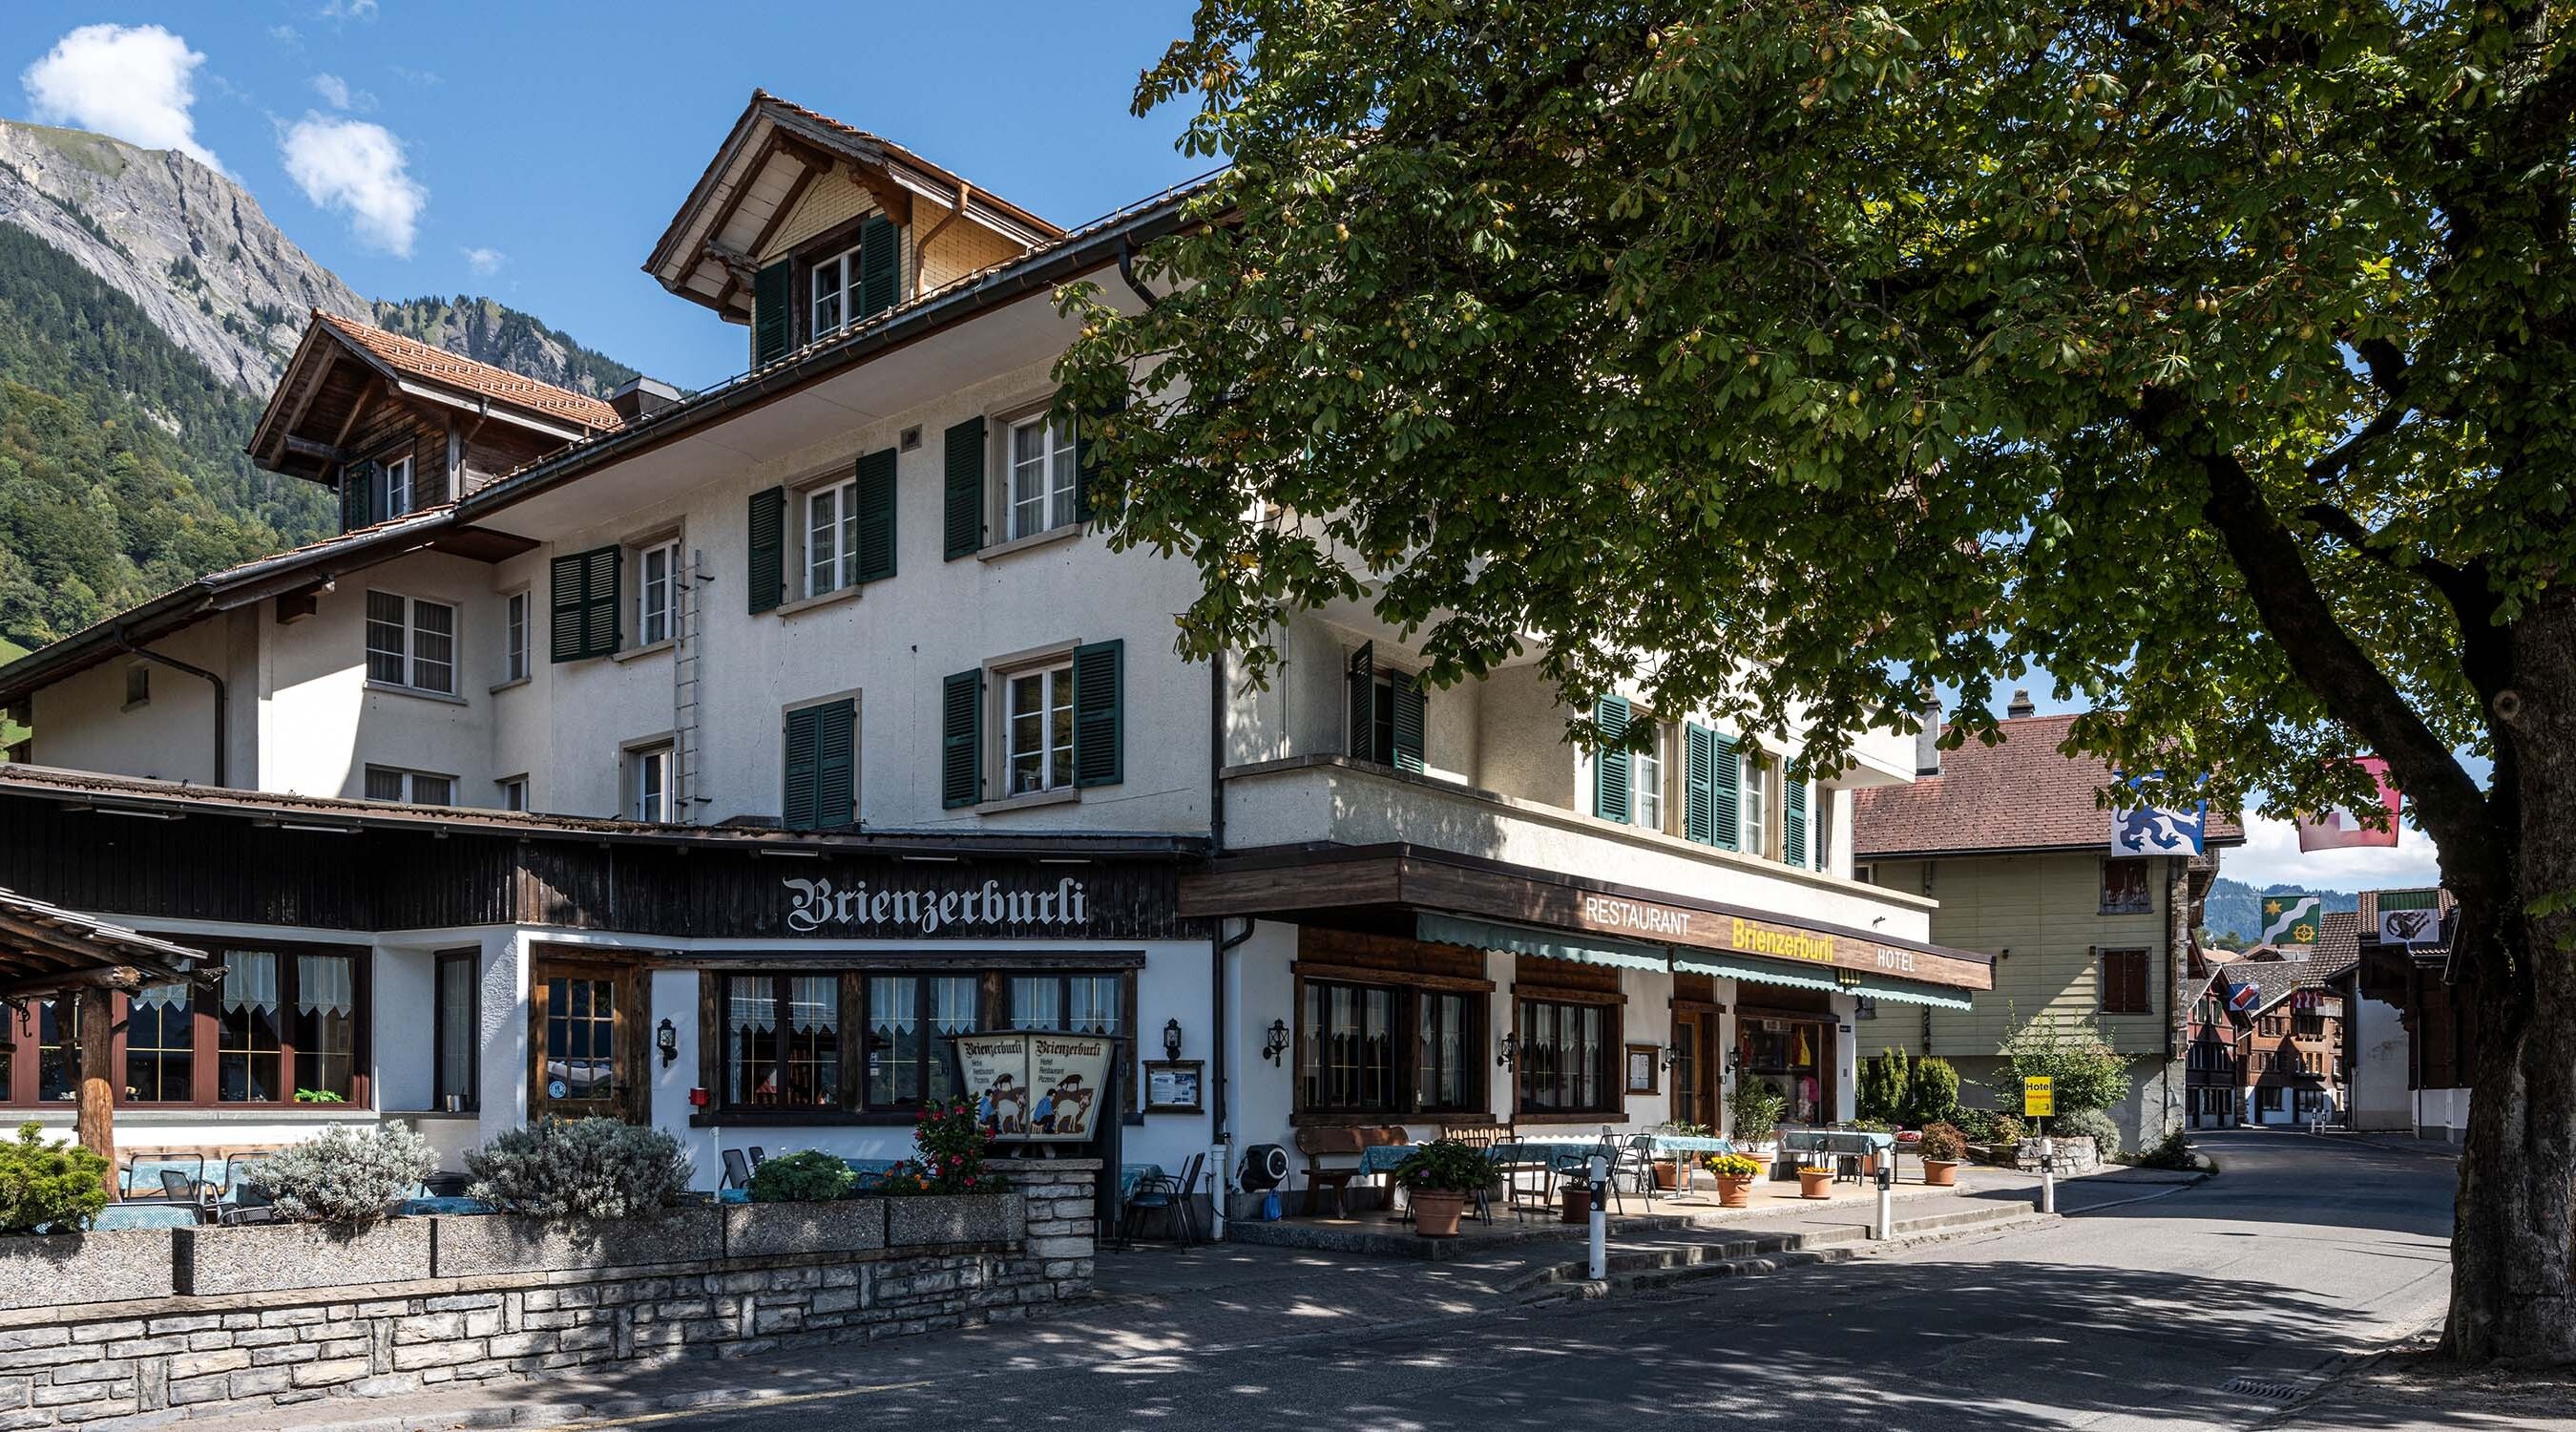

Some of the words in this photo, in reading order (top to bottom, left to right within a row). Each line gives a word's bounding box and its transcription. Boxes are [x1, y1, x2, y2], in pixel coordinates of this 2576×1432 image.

[783, 877, 1087, 933] Brienzerburli
[1585, 896, 1691, 937] RESTAURANT
[1731, 917, 1834, 963] Brienzerburli
[1877, 948, 1916, 973] HOTEL
[964, 1040, 1022, 1058] Brienzerburli
[1036, 1040, 1100, 1057] Brienzerburli
